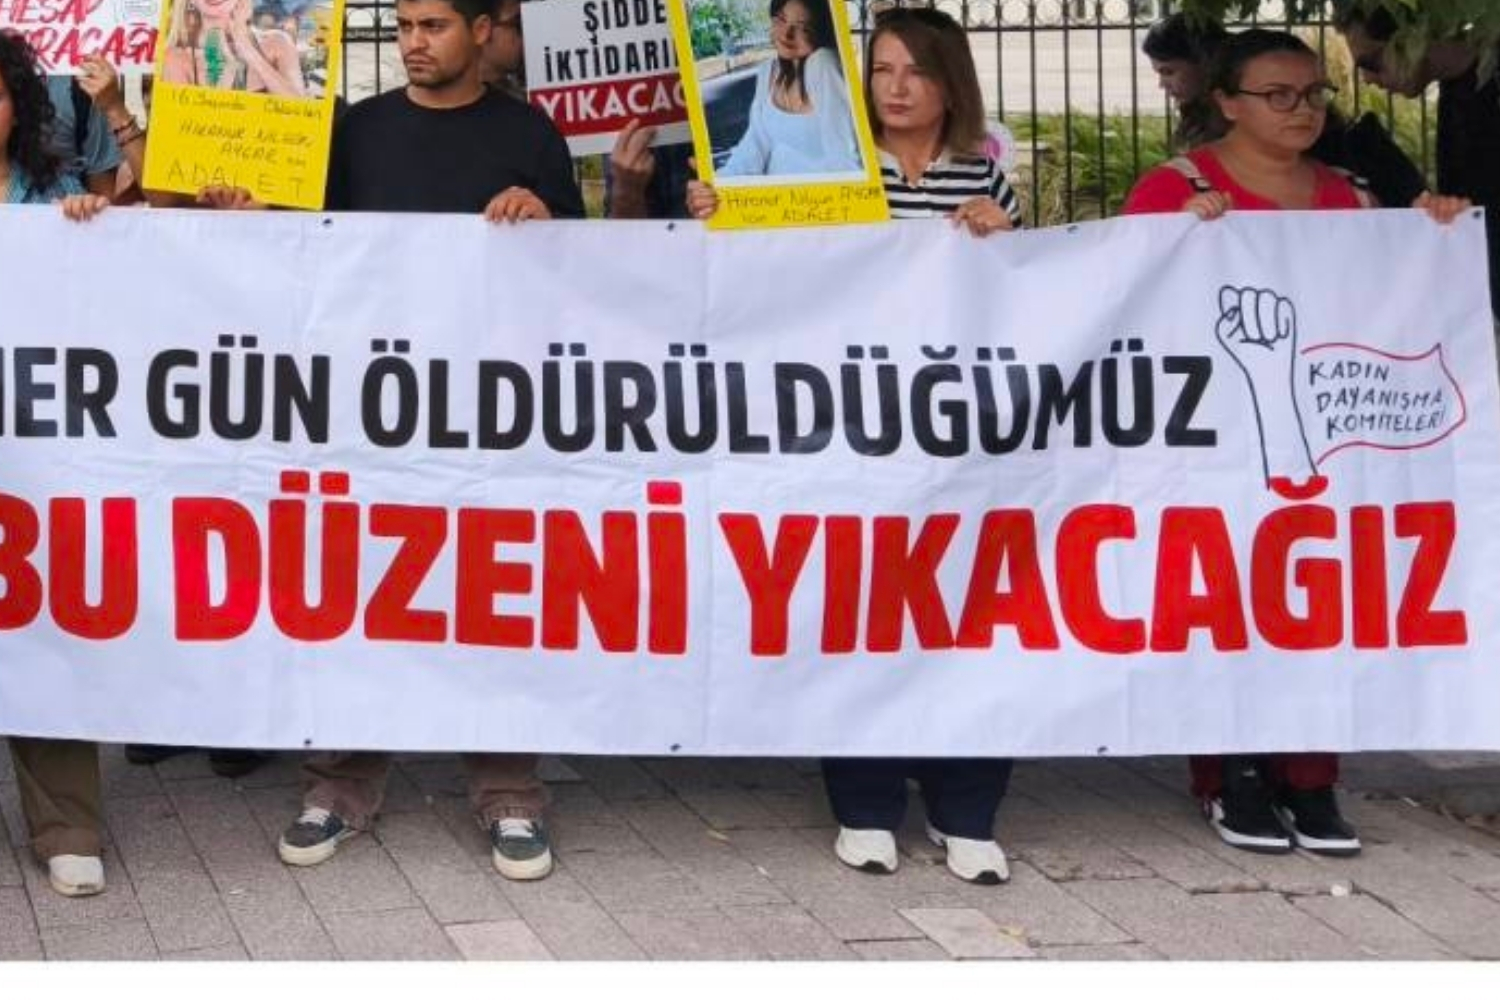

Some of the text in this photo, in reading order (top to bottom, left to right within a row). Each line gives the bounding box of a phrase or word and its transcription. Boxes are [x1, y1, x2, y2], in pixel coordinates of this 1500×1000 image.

[146, 334, 331, 444] GÜN
[360, 337, 1218, 458] ÖLDÜRÜLDÜĞÜMÜZ
[1309, 360, 1390, 386] KADIN
[1315, 386, 1444, 413] DAYANIŞMA
[171, 470, 687, 656] DÜZENİ
[717, 473, 1469, 657] YIKACAĞIZ
